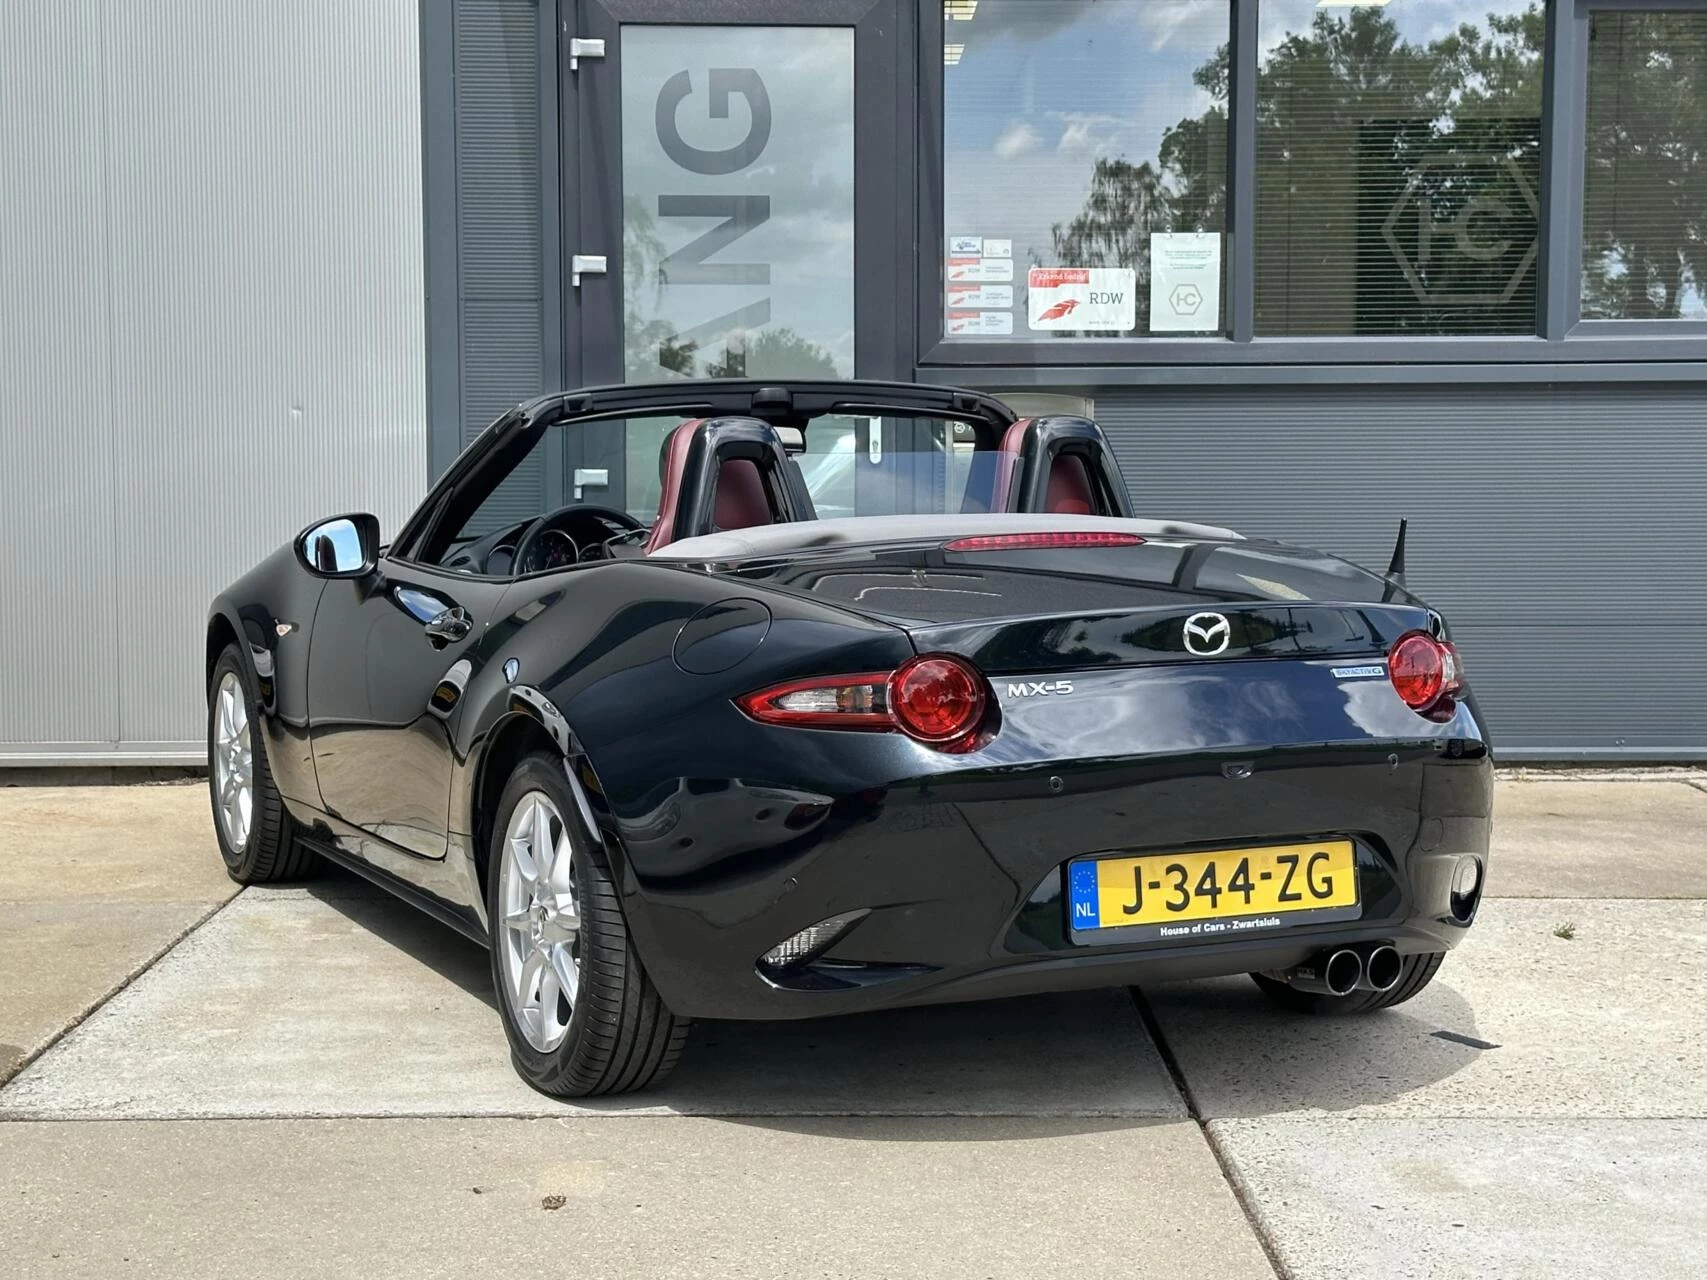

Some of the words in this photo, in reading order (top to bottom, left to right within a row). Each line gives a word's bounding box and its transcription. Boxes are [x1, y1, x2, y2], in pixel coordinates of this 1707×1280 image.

[1089, 292, 1124, 305] RDW
[1007, 680, 1074, 698] MX-5
[1122, 852, 1334, 915] J-344-ZG
[1075, 901, 1096, 918] NL
[1160, 926, 1190, 936] House
[1192, 924, 1202, 934] of
[1204, 922, 1226, 933] Cars
[1232, 917, 1281, 930] Zwartsluis
